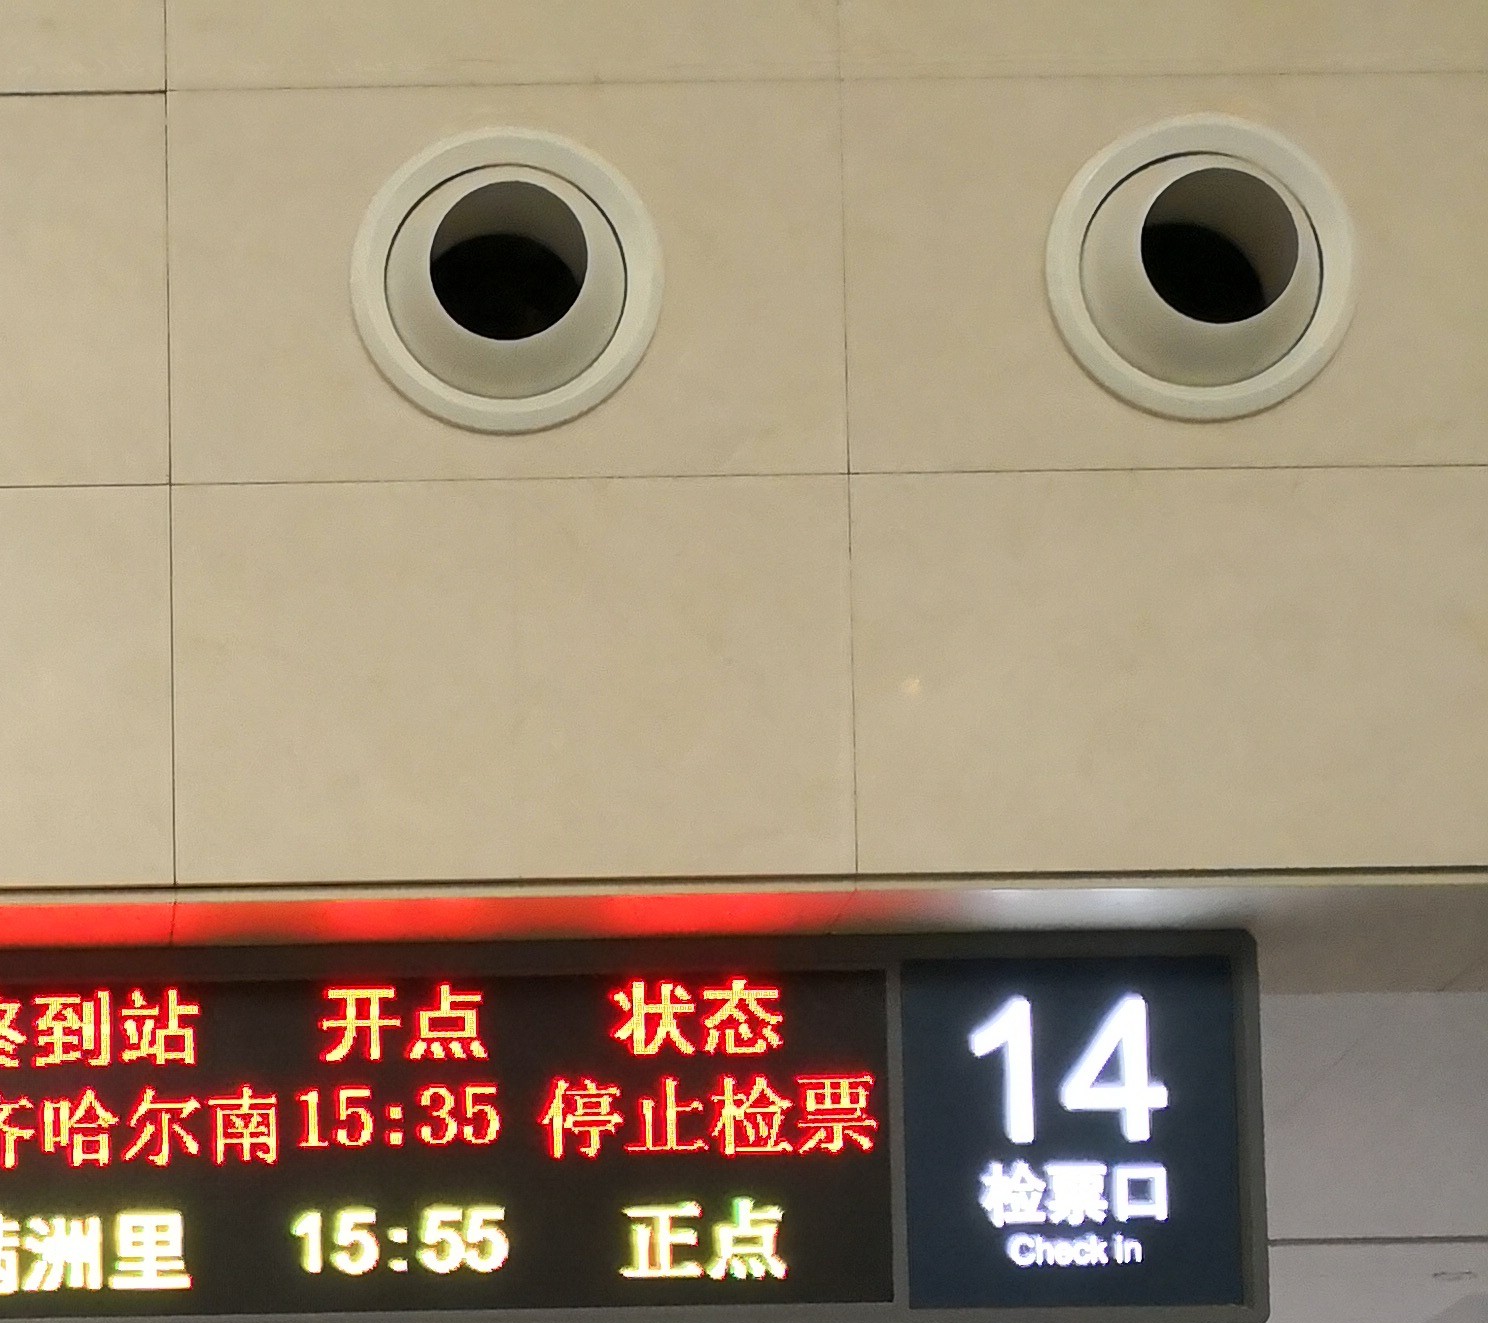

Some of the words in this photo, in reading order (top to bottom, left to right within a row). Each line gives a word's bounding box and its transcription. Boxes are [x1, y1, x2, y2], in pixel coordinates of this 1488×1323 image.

[317, 981, 489, 1064] 开点
[608, 975, 784, 1058] 状态
[969, 993, 1169, 1144] 14
[294, 1081, 503, 1150] 15:35
[536, 1071, 879, 1161] 停止检票
[979, 1159, 1169, 1227] 检票口
[291, 1204, 510, 1276] 15:55
[619, 1197, 787, 1280] 正点
[1007, 1232, 1108, 1267] Check
[1113, 1232, 1143, 1265] in
